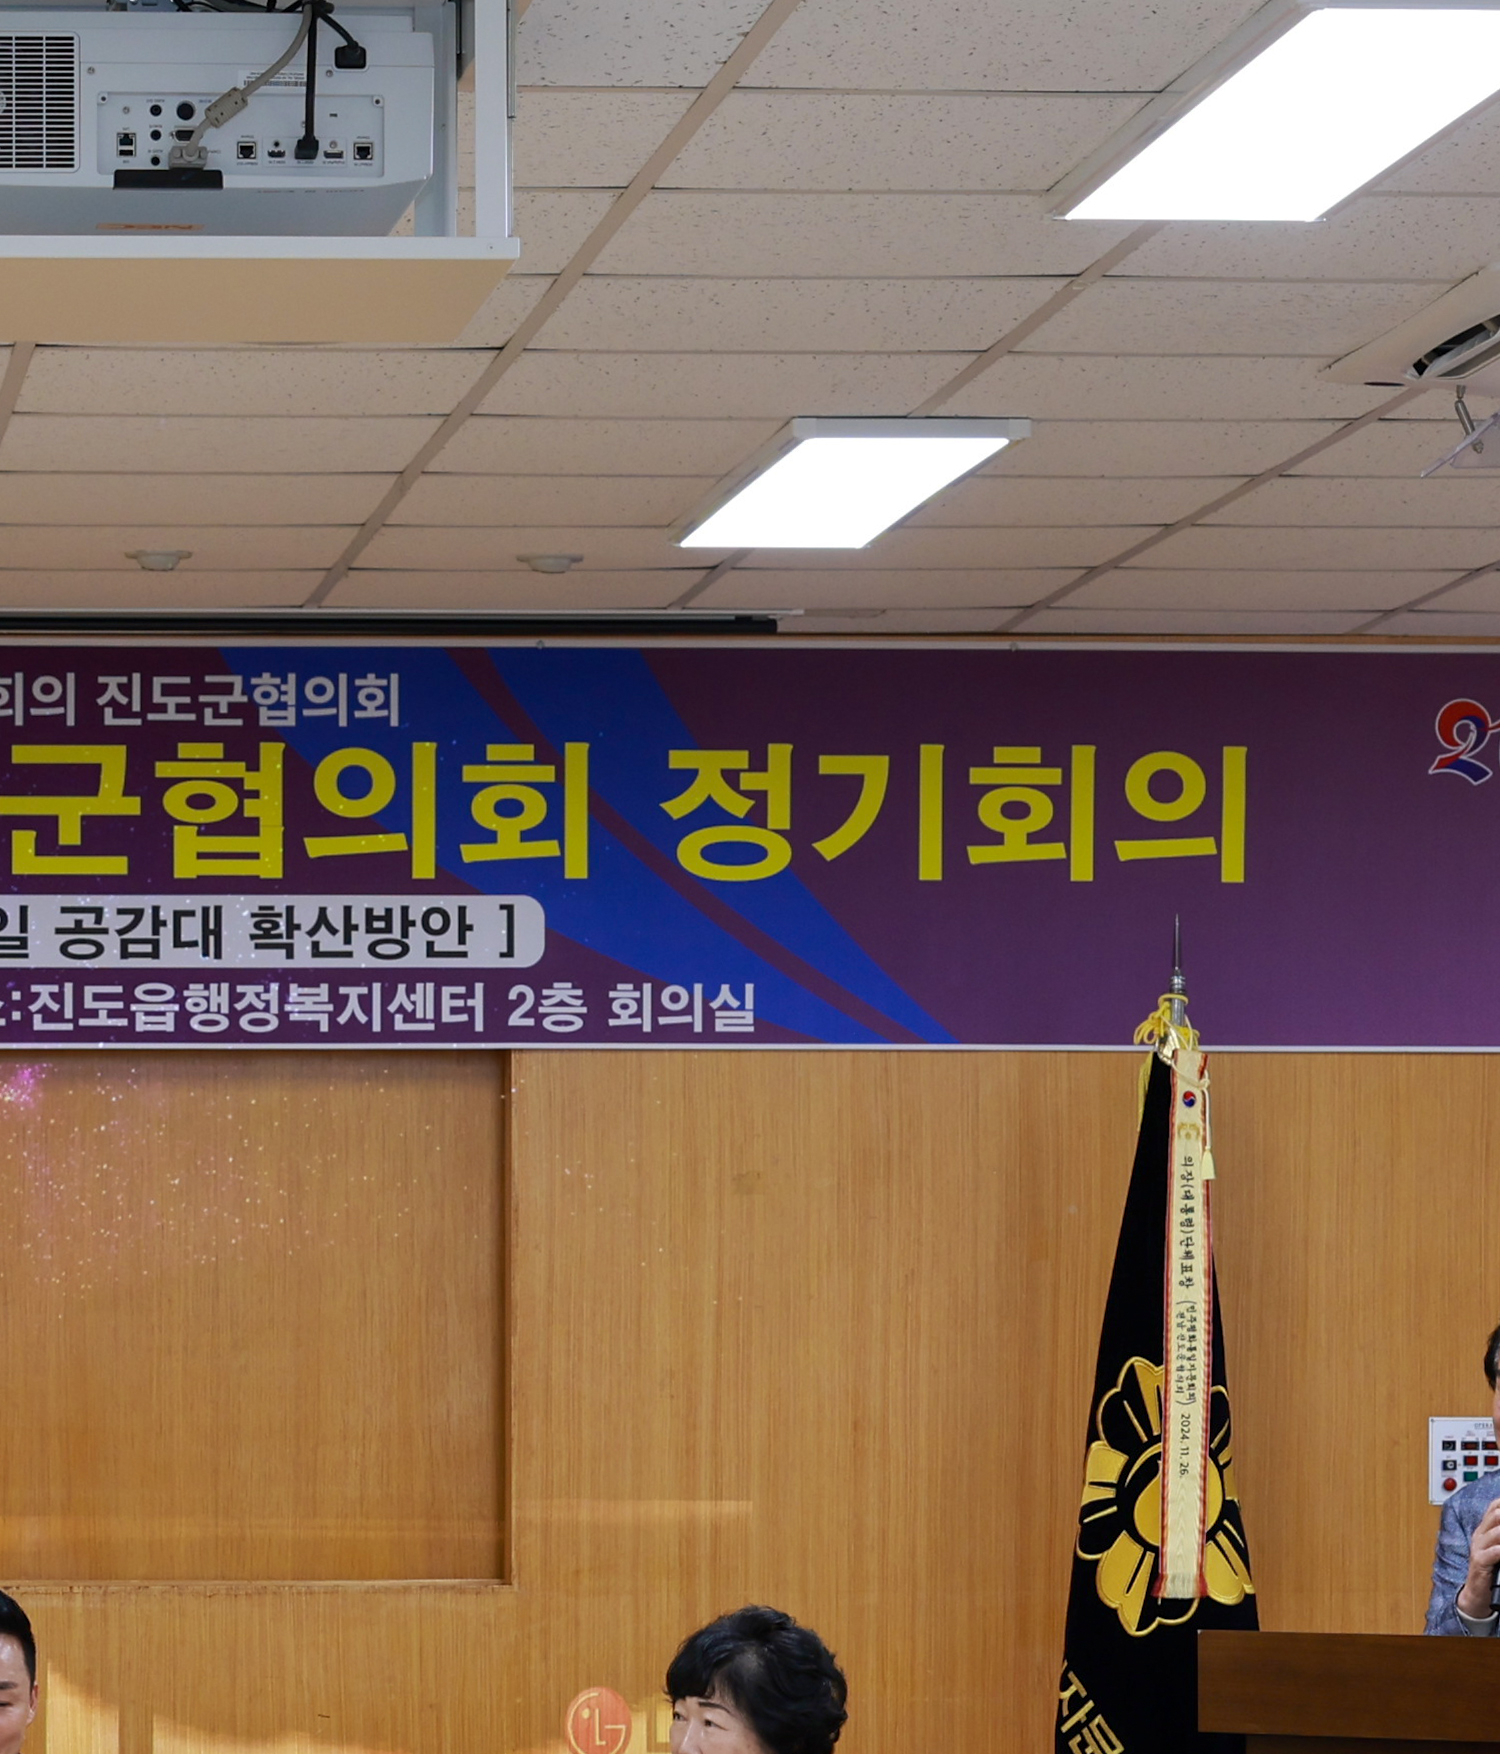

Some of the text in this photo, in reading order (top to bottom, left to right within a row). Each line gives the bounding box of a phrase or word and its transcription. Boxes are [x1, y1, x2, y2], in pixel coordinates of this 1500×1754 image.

[98, 674, 397, 726] 진도군협의회
[662, 744, 1247, 882] 정기회의
[55, 906, 222, 960] 공감대
[250, 906, 473, 960] 확산방안
[508, 983, 587, 1032] 2층
[609, 983, 754, 1032] 회의실
